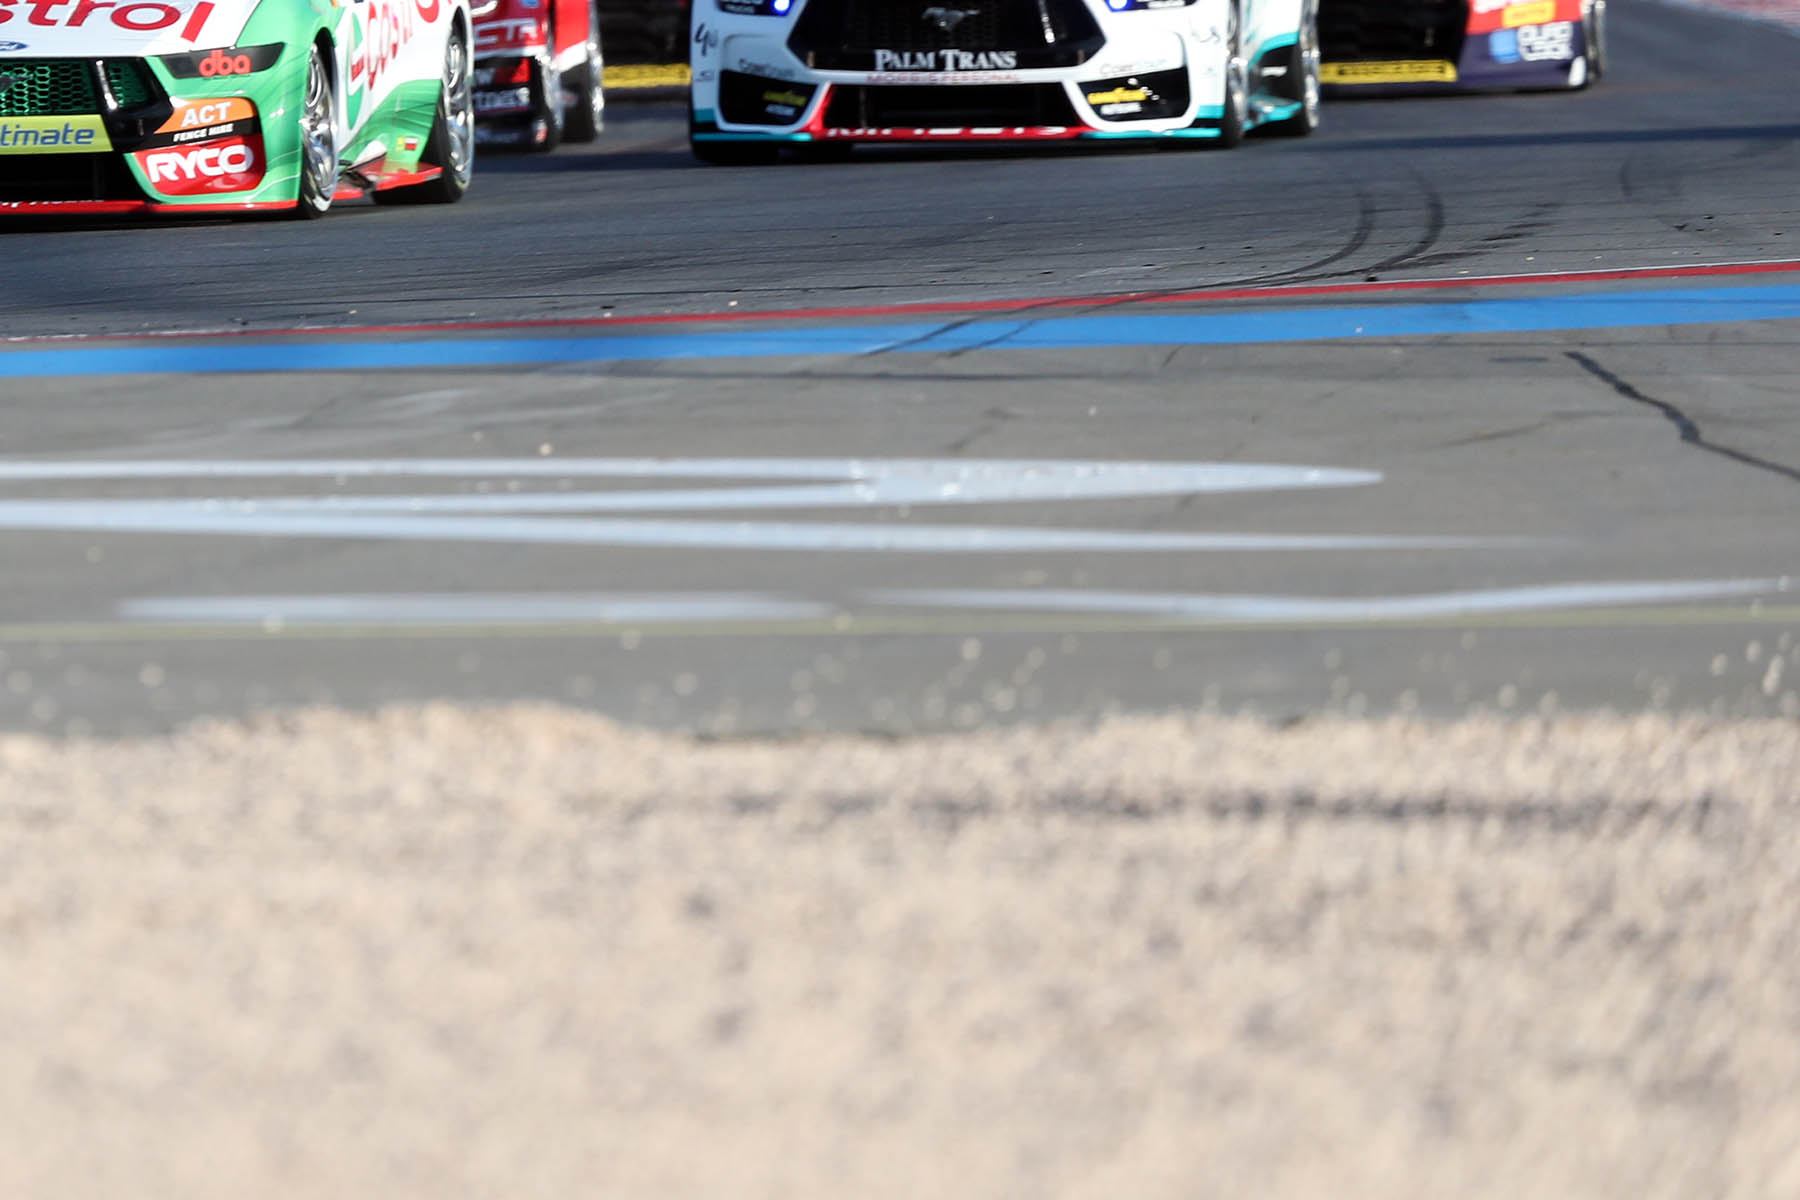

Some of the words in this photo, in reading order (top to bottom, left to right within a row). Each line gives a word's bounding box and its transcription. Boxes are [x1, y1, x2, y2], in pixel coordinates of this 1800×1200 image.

[199, 50, 251, 77] dba
[874, 49, 935, 70] PALM
[940, 49, 1018, 70] TRANS
[181, 101, 232, 127] ACT
[146, 144, 254, 183] RYCO
